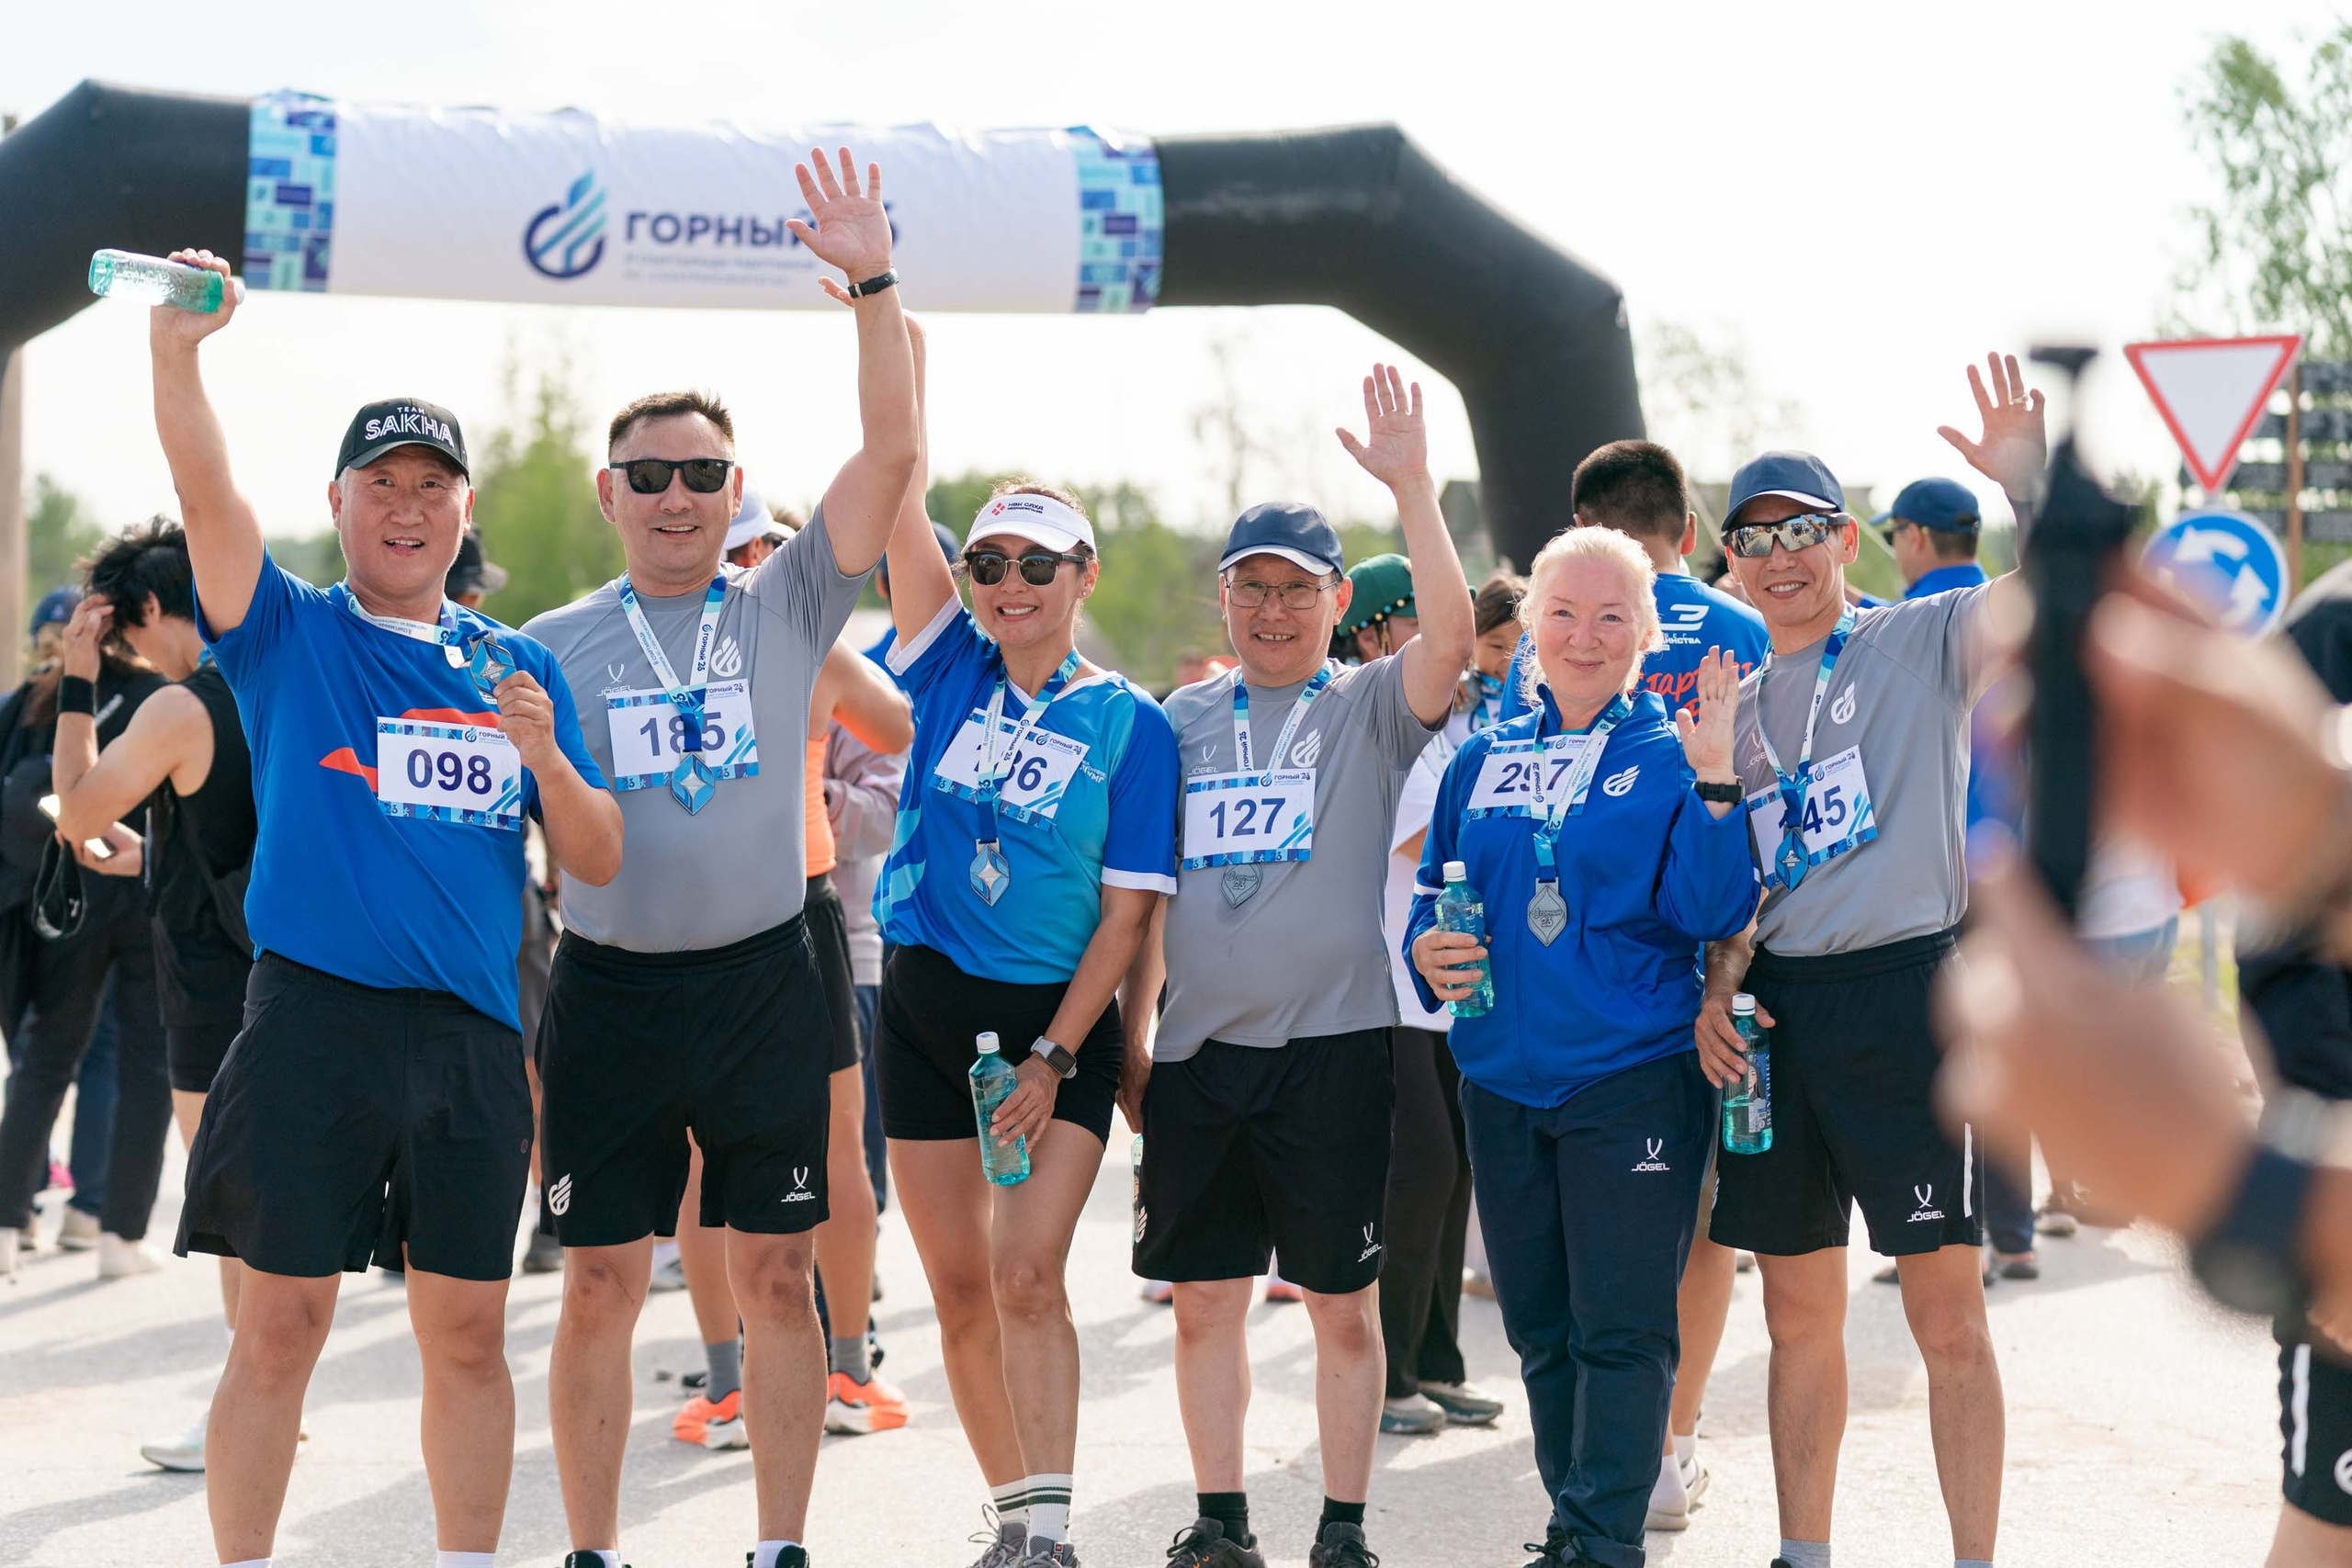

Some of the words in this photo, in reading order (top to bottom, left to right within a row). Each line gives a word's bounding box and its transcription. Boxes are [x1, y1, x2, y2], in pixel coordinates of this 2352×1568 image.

[365, 413, 455, 448] SAKHA
[698, 633, 709, 660] ГОРНЫЙ
[1664, 637, 1702, 645] ИНСТВА
[706, 684, 733, 694] ГОРНЫЙ
[479, 731, 505, 740] ГОРНЫЙ
[639, 711, 727, 757] 185
[1009, 727, 1025, 750] ГОРНЫЙ
[1049, 738, 1074, 750] ГОРНЫЙ
[1241, 741, 1250, 767] ГОРНЫЙ
[1188, 765, 1220, 775] JÖGEL
[1825, 756, 1847, 771] ГОРНЫЙ
[407, 749, 492, 795] 098
[1209, 797, 1286, 839] 127
[1631, 1161, 1670, 1172] JÖGEL
[781, 1191, 816, 1202] JÖGEL
[1906, 1210, 1945, 1223] JÖGEL
[1358, 1243, 1382, 1262] JÖGEL
